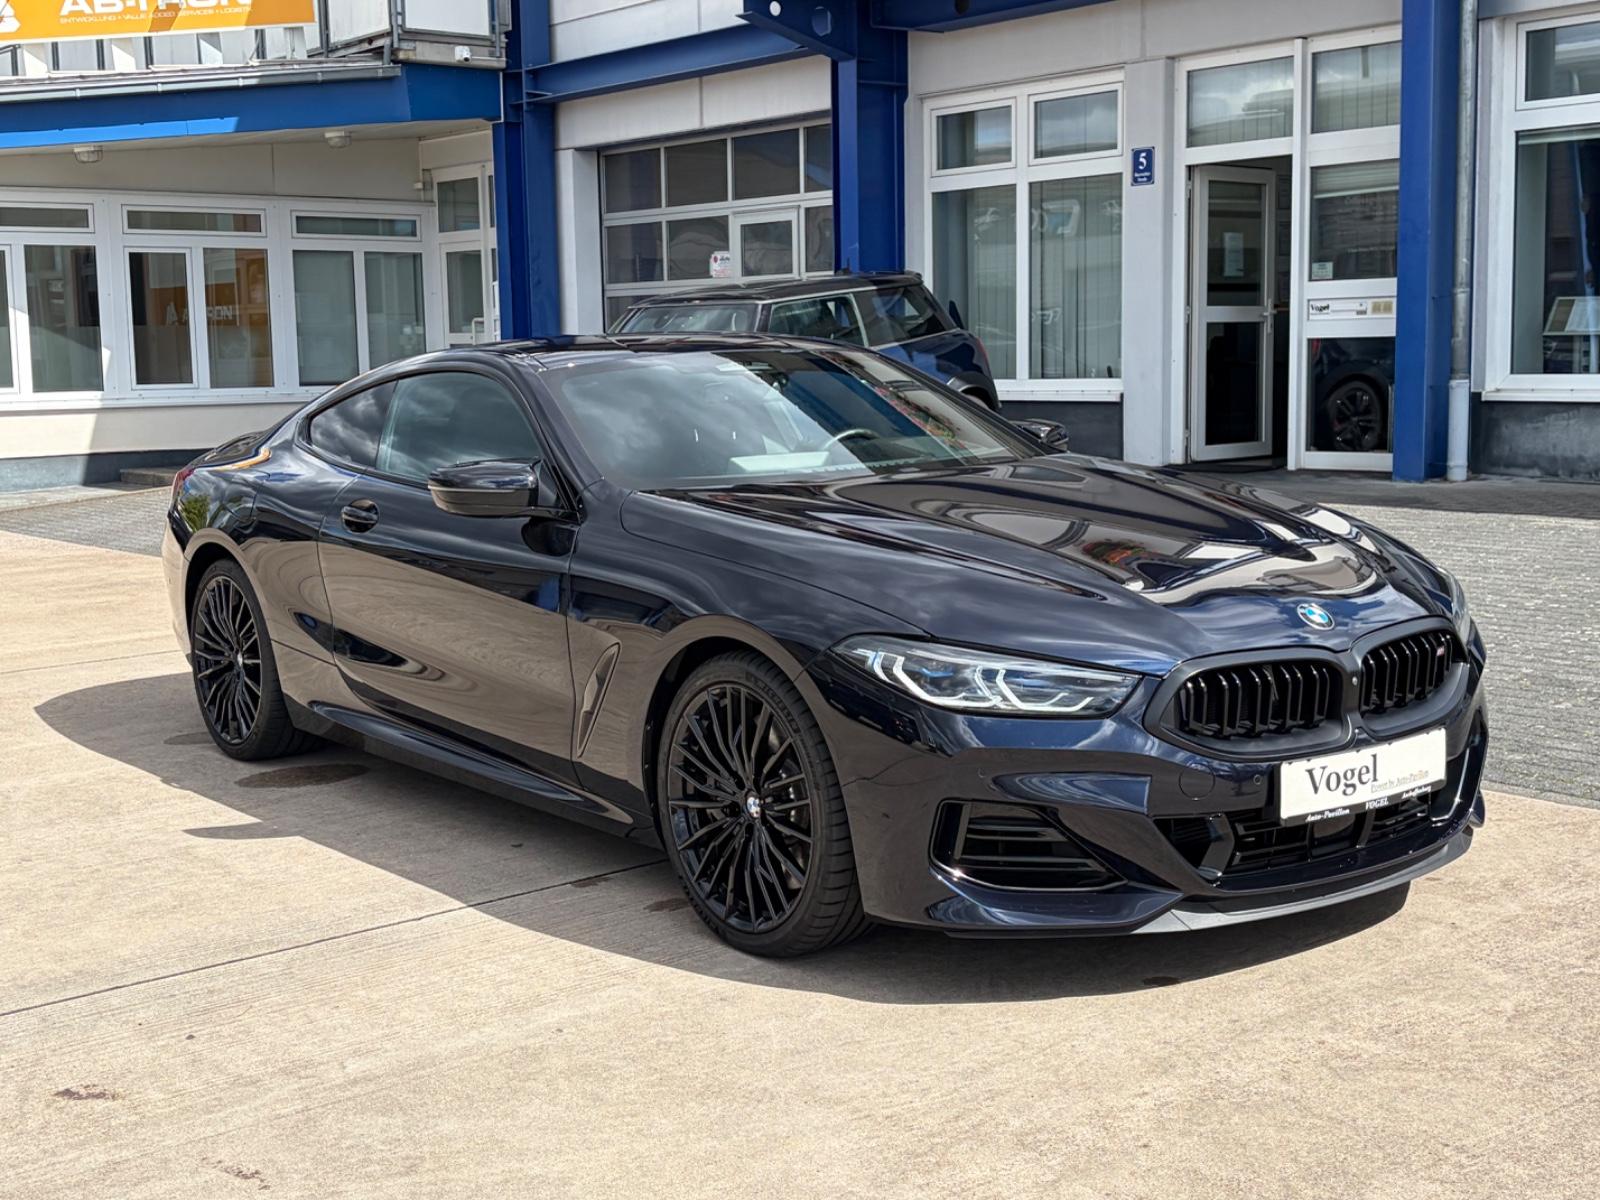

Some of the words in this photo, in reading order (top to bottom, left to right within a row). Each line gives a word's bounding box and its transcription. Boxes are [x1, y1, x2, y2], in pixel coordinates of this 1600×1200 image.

[1138, 152, 1147, 170] 5
[1305, 753, 1378, 797] Vogel
[1365, 797, 1389, 811] VOGEL
